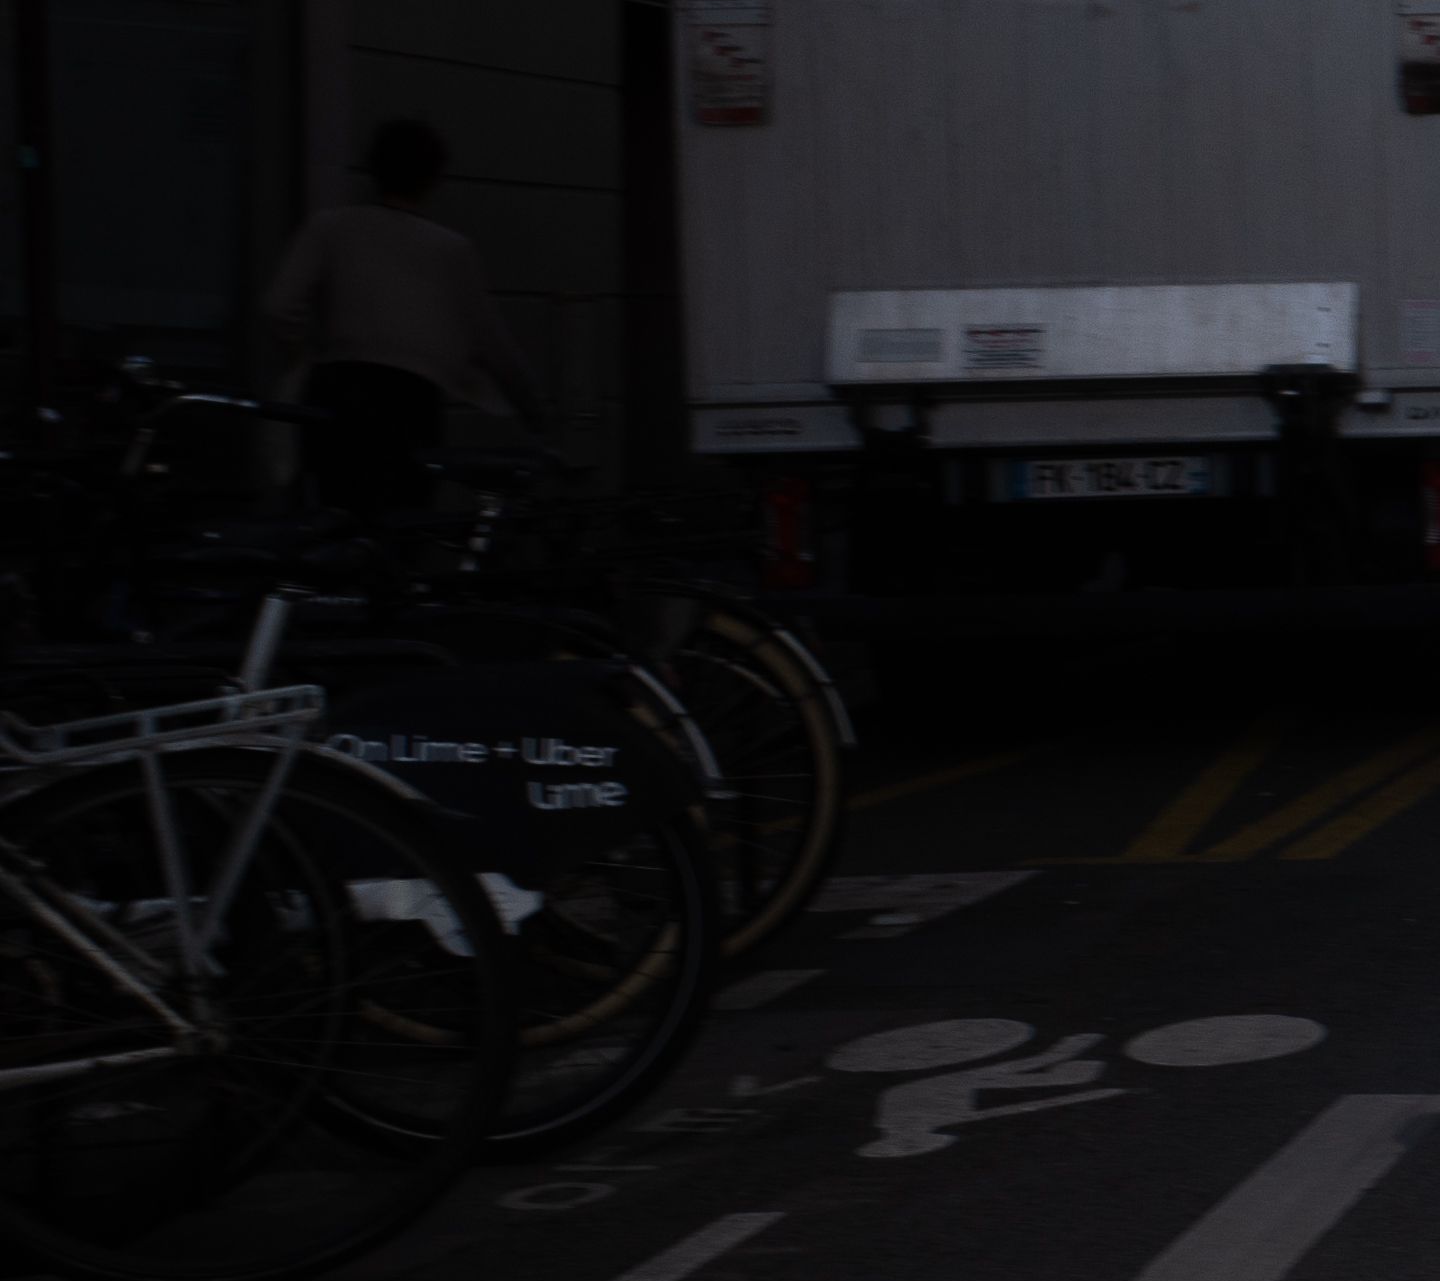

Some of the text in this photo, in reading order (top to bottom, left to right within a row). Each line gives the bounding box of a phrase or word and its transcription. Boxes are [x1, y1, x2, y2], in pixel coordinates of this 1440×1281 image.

[389, 734, 489, 763] Lime
[521, 737, 620, 767] Uber
[526, 781, 630, 810] Lime
